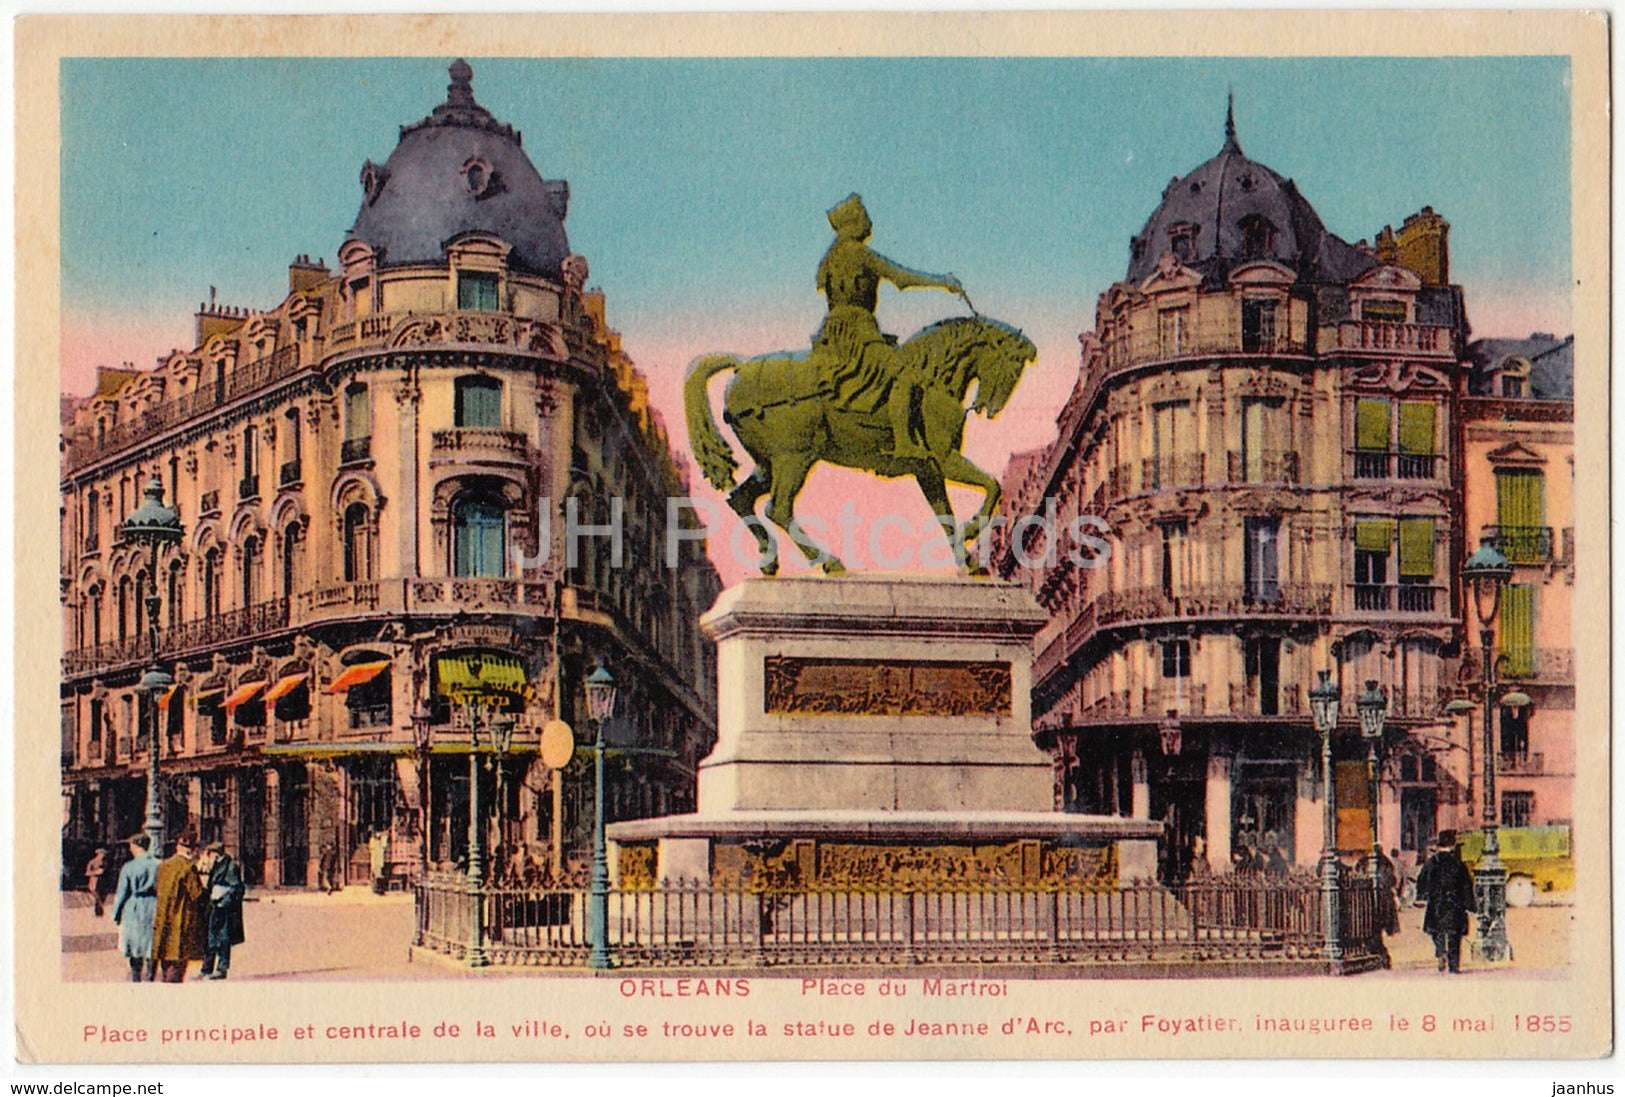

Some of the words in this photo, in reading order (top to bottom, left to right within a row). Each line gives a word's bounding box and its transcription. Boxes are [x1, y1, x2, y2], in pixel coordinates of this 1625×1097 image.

[619, 979, 751, 998] ORLEANS
[801, 979, 867, 997] Place
[878, 979, 907, 997] du
[922, 979, 1008, 997] Martroi
[83, 1024, 149, 1043] Place
[160, 1023, 279, 1045] principale
[293, 1024, 314, 1041] et
[325, 1020, 421, 1041] centrale
[432, 1020, 460, 1039] de
[475, 1020, 497, 1039] la
[511, 1019, 571, 1041] ville,
[584, 1020, 612, 1038] où
[623, 1023, 649, 1038] se
[662, 1020, 735, 1038] trouve
[747, 1019, 768, 1037] la
[783, 1019, 856, 1038] statue
[867, 1018, 895, 1037] de
[904, 1018, 990, 1037] Jeanne
[1089, 1017, 1129, 1037] par
[1389, 1013, 1411, 1032] le
[1421, 1013, 1437, 1033] 8
[1452, 1014, 1495, 1033] mai
[1514, 1013, 1573, 1034] 1855
